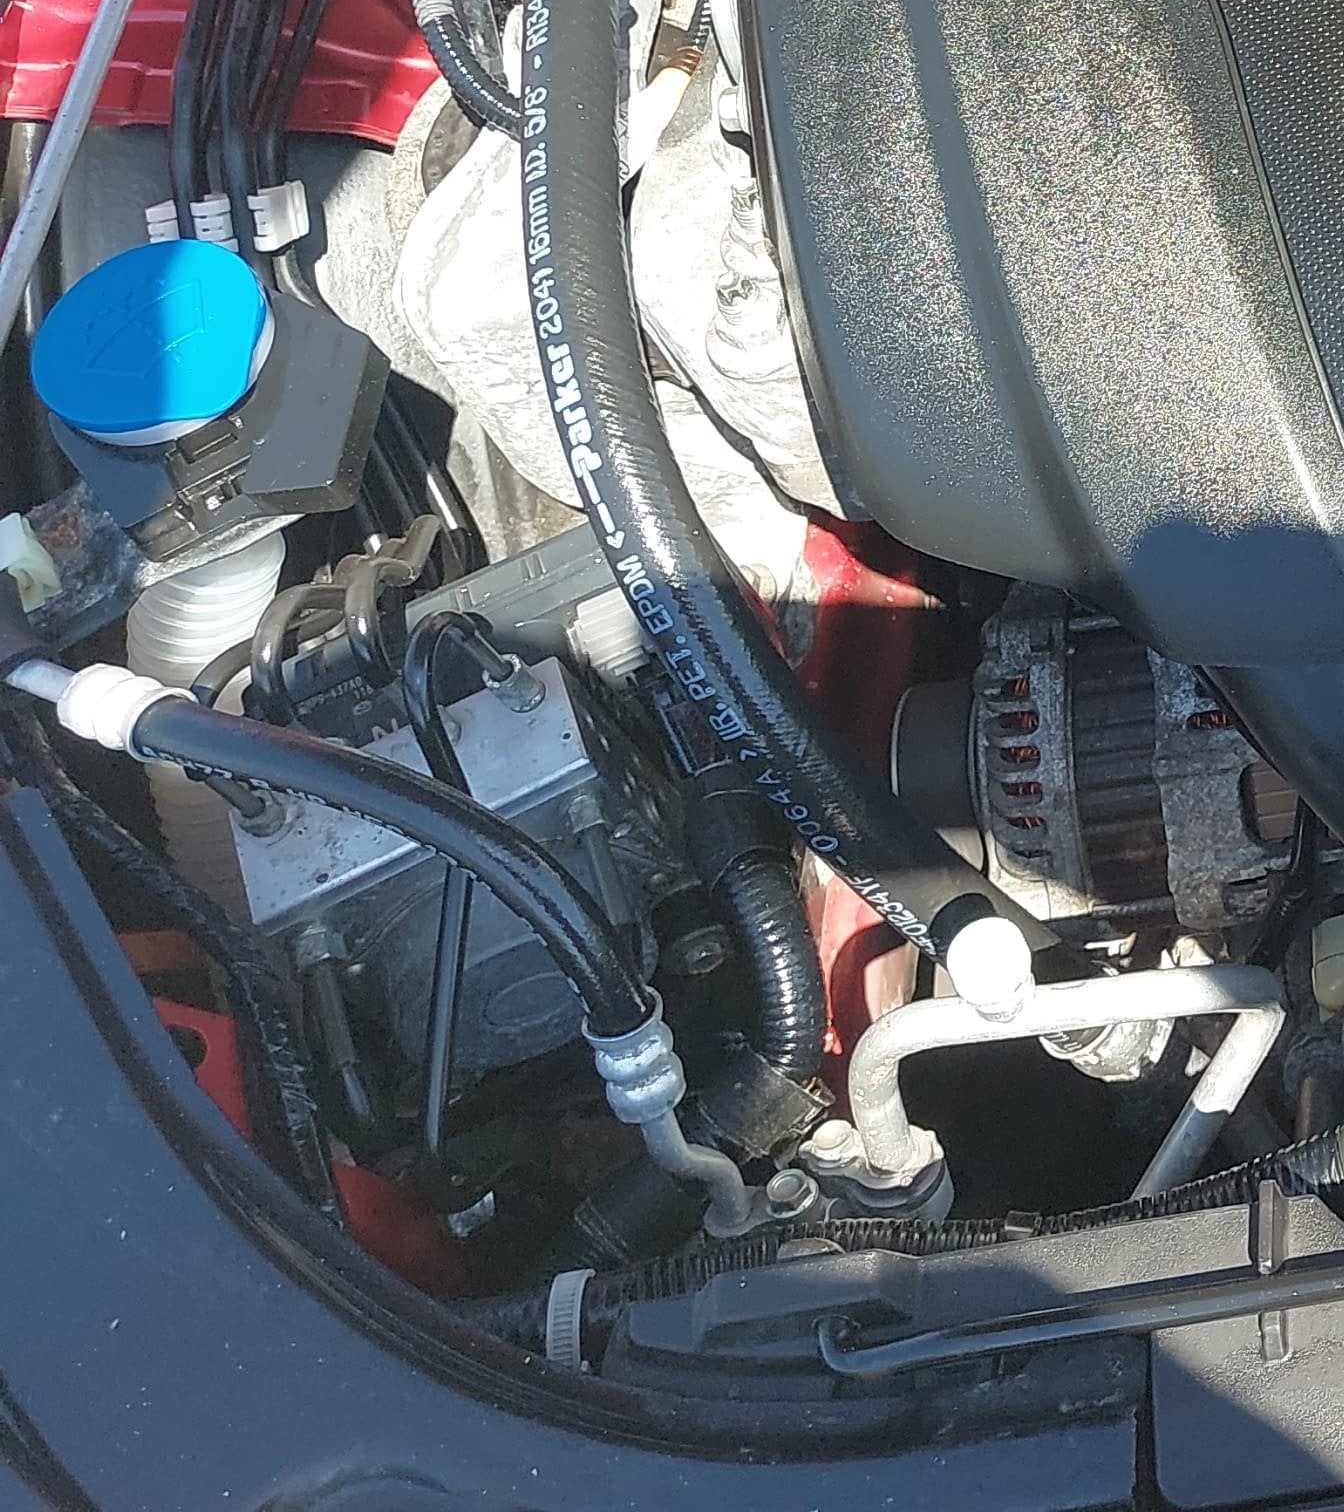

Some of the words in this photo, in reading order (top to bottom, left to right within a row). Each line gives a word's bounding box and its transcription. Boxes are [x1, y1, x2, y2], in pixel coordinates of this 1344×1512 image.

[529, 186, 552, 265] 16mm
[532, 267, 563, 339] 2041
[547, 343, 602, 478] Parker
